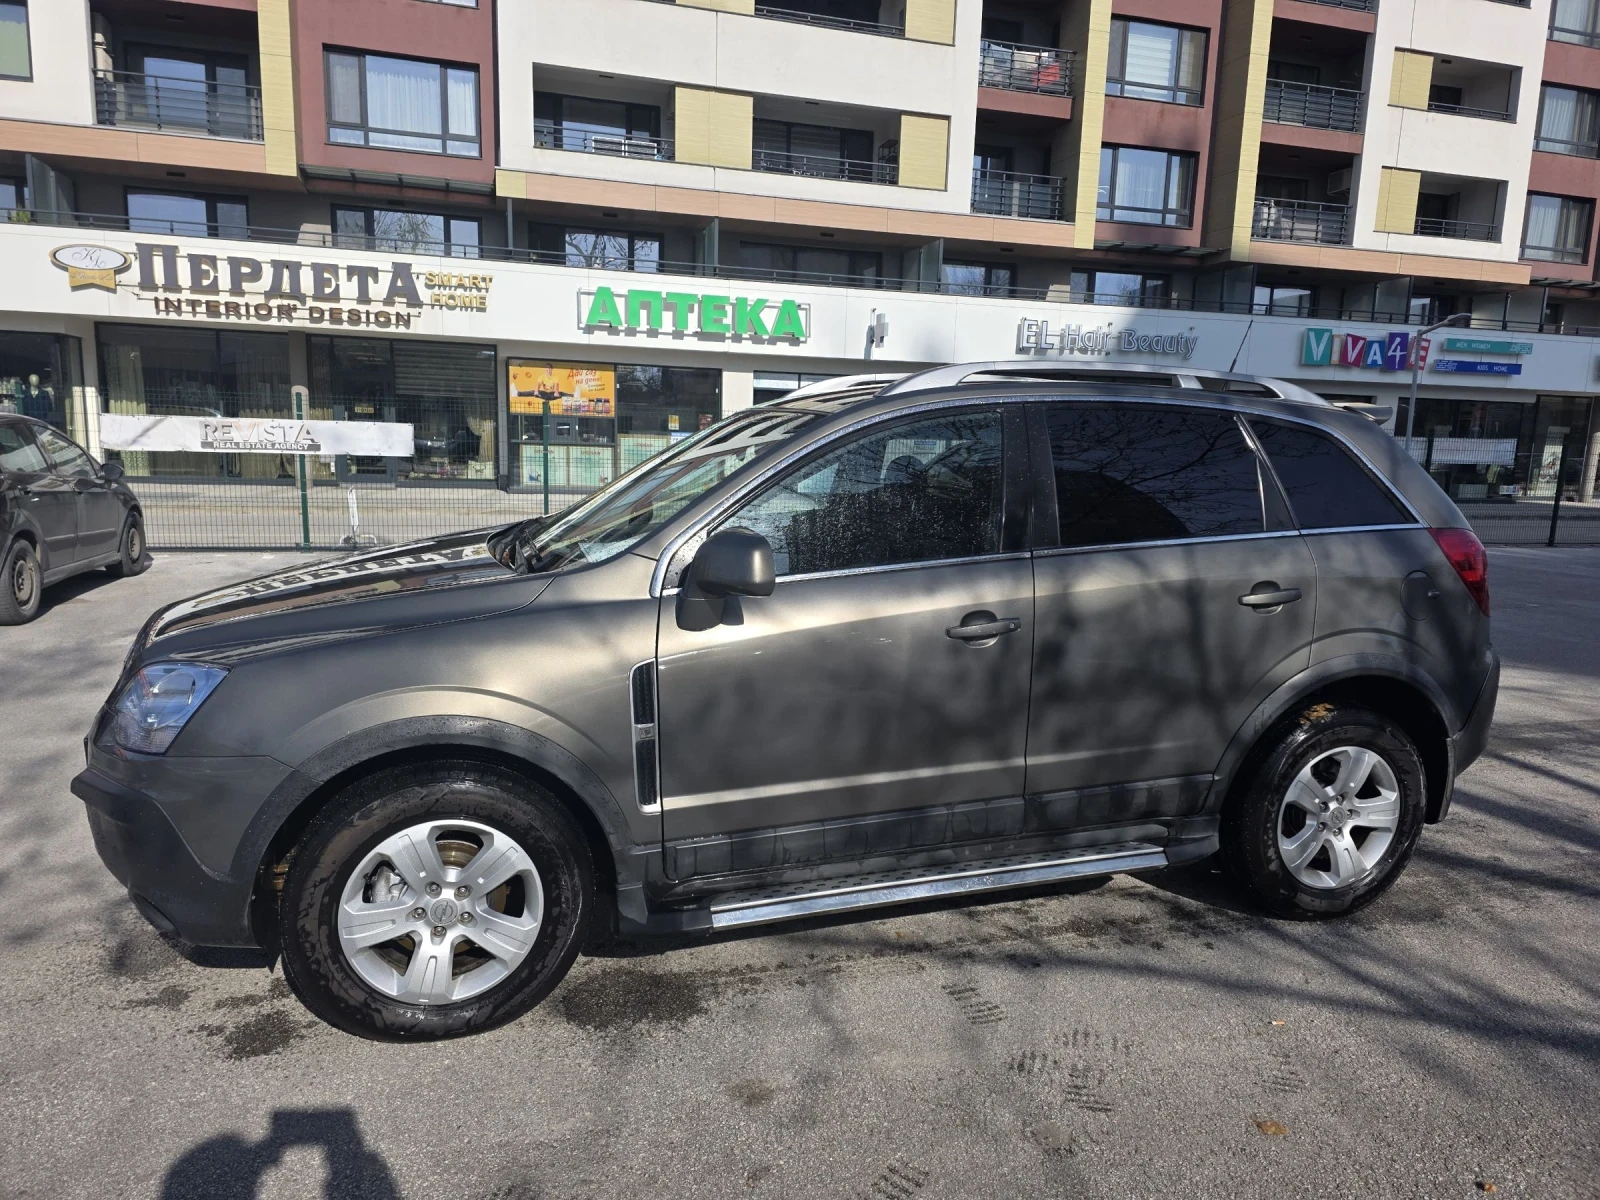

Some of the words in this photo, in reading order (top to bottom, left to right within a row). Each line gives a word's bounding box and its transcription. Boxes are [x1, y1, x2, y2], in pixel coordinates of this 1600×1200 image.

[135, 243, 423, 306] ПЕРДЕТА
[425, 271, 493, 291] SMART
[154, 296, 297, 319] INTERIOR
[308, 306, 411, 328] DESIGN
[430, 292, 487, 309] HOME
[586, 286, 806, 338] АПТЕКА
[1022, 317, 1054, 350] EL
[1065, 323, 1113, 350] Hair
[1120, 328, 1199, 359] Beauty
[201, 421, 320, 443] REVISTA
[213, 441, 237, 449] REAL
[239, 442, 273, 450] ESTATE
[274, 442, 309, 450] AGENCY
